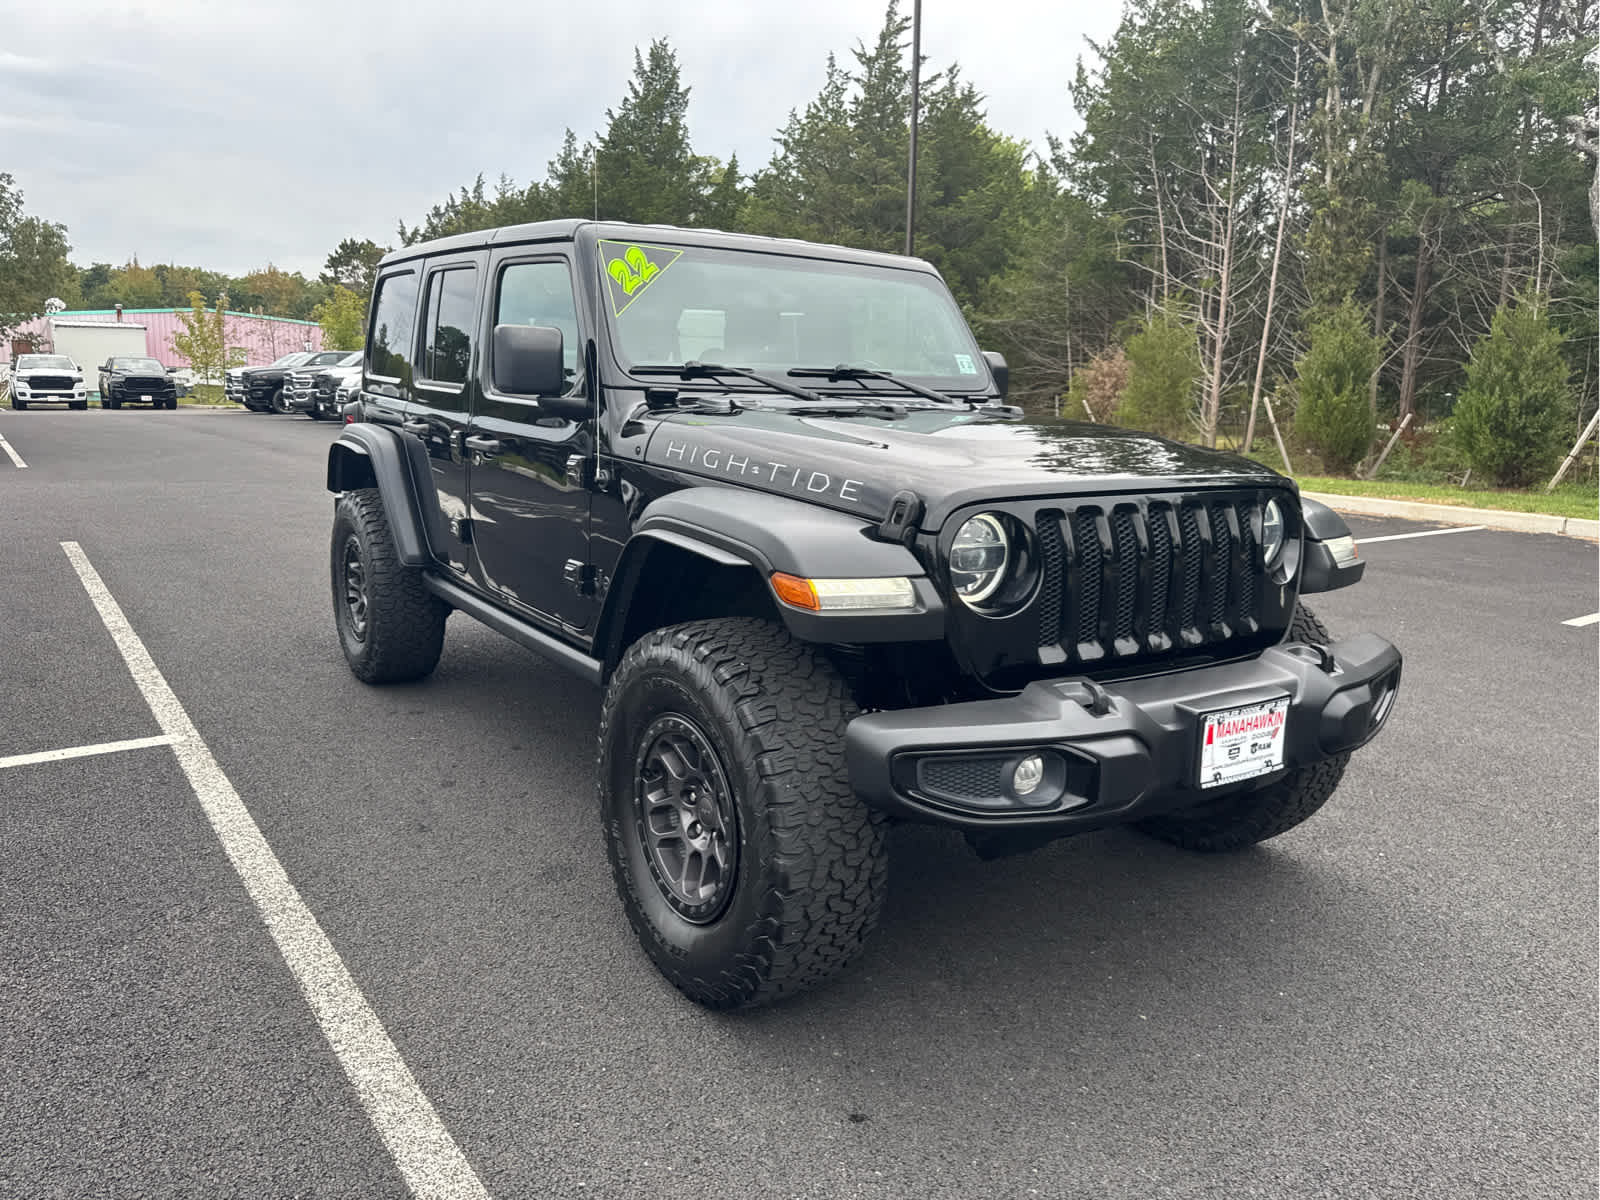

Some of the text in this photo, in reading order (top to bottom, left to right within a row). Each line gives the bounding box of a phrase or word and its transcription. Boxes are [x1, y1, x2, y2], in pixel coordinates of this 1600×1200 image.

[607, 246, 660, 296] 22
[665, 441, 864, 502] HIGH TIDE
[1216, 711, 1285, 738] MANAHAWKIN
